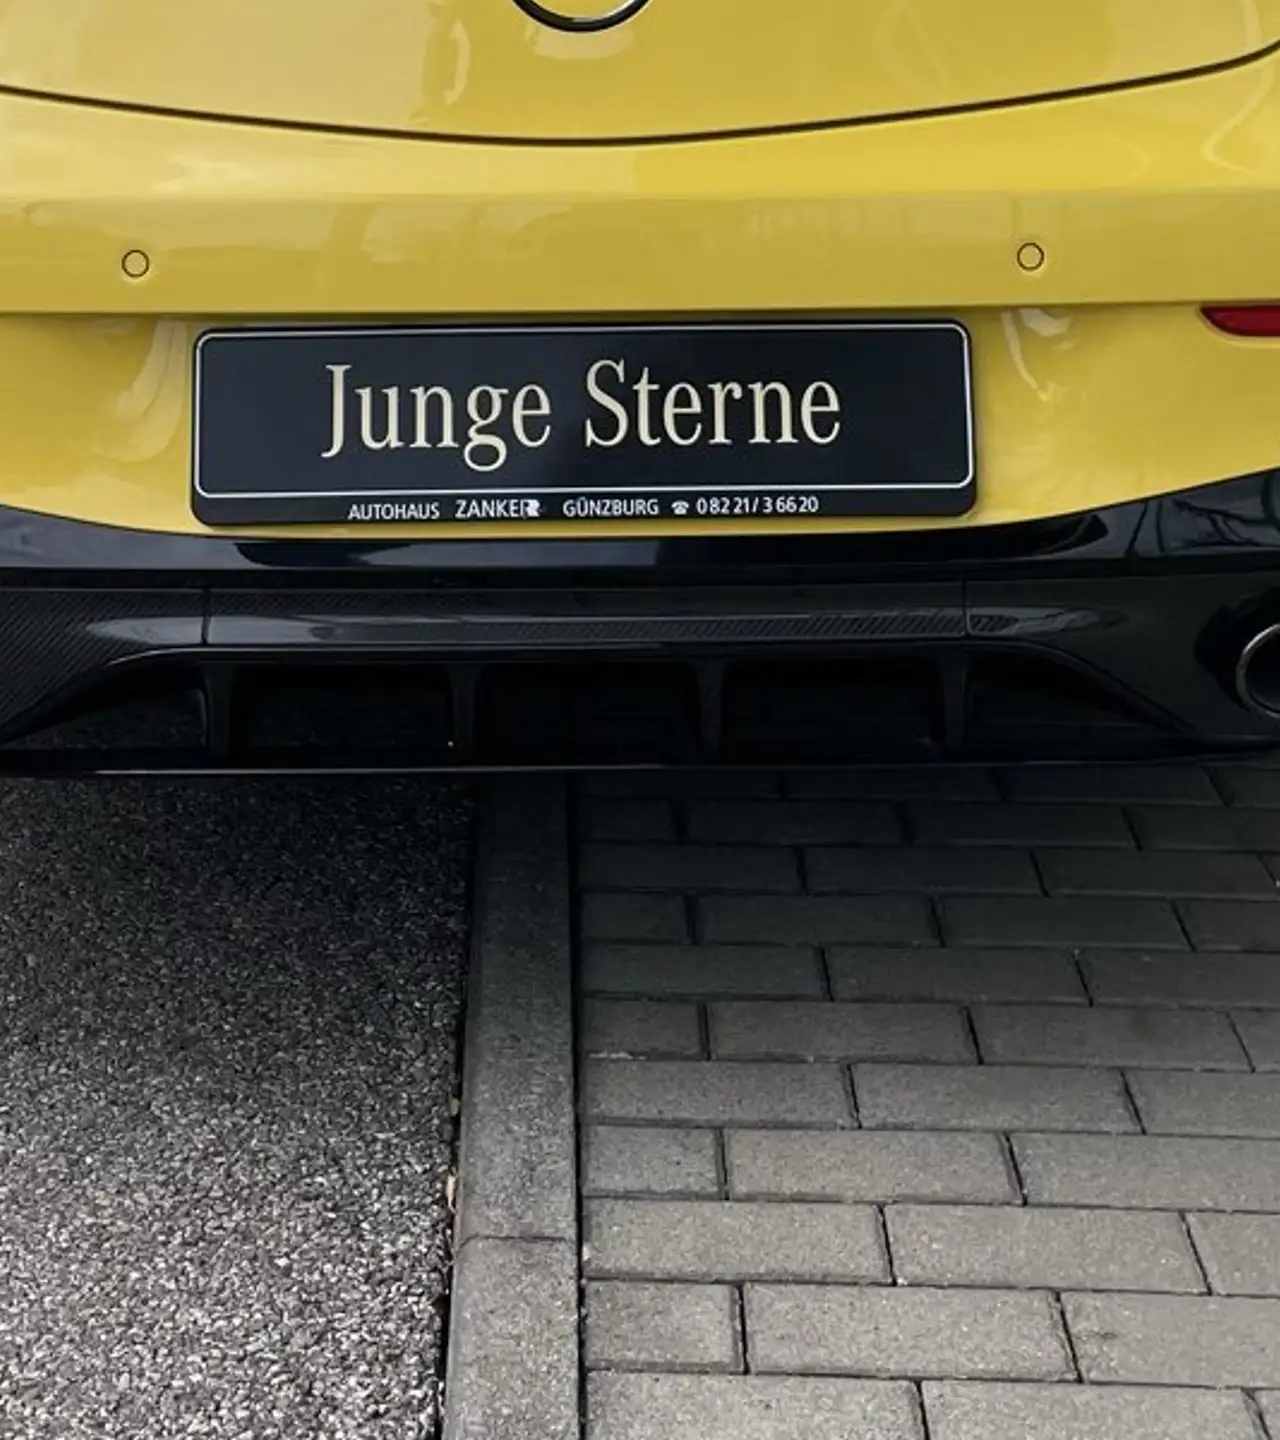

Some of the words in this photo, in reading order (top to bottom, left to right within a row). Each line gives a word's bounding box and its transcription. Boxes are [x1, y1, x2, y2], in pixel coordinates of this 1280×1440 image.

[320, 363, 551, 473] Junge
[584, 359, 841, 449] Sterne
[348, 501, 440, 521] AUTOHAUS
[455, 498, 540, 519] ZANKER
[562, 497, 659, 517] GÜNZBURG
